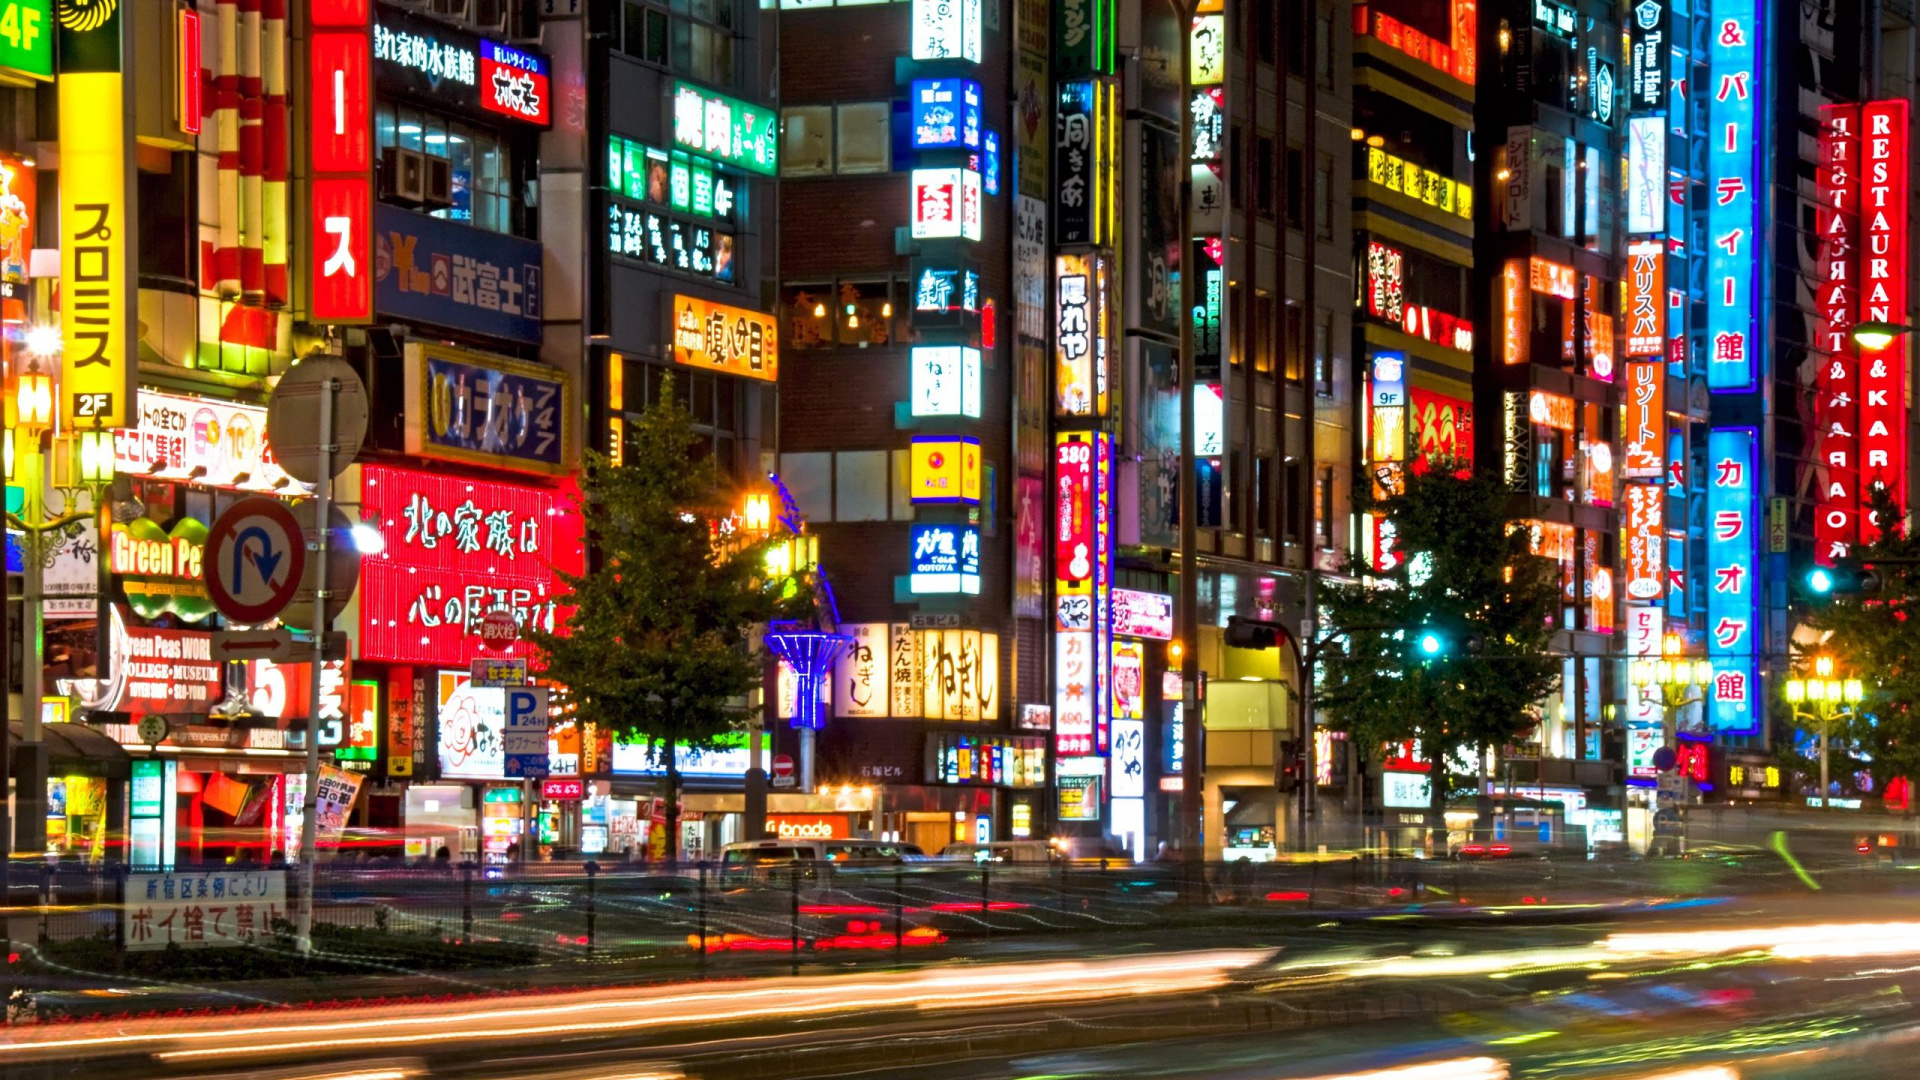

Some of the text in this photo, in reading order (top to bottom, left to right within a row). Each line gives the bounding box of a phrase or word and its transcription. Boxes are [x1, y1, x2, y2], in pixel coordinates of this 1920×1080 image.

[0, 3, 40, 51] 4F
[494, 45, 538, 72] 新しいタイプの
[1634, 43, 1644, 95] Glamorize
[1645, 31, 1661, 104] Trans Hair
[325, 69, 355, 277] ース
[714, 180, 732, 216] 4F
[696, 229, 709, 248] A5
[1066, 231, 1080, 241] 4F
[74, 203, 112, 368] プロミス
[452, 253, 523, 316] 武富士
[528, 269, 535, 314] 4F
[1206, 269, 1221, 356] EXCELSIOR
[1868, 114, 1892, 547] RESTAURAN & KARO
[706, 310, 762, 370] 腹八分目
[79, 394, 107, 416] 2F
[1380, 393, 1397, 405] 9F
[1634, 365, 1657, 446] リゾート
[534, 385, 557, 456] 747
[1059, 446, 1090, 464] 380
[1627, 441, 1662, 468] カフェ
[404, 492, 538, 560] 北の家族は
[1628, 486, 1645, 528] ネット
[1646, 486, 1662, 527] マンガ
[115, 532, 173, 577] Green
[178, 537, 205, 582] Pe
[917, 564, 954, 572] OOTOYA
[1630, 536, 1644, 580] シャワー
[1633, 582, 1657, 595] 24H
[1714, 458, 1747, 703] カラオケ館
[484, 622, 515, 640] 消火栓
[914, 615, 958, 631] 石塚ビル
[155, 635, 181, 659] Peas
[182, 637, 211, 661] WORL
[895, 637, 912, 683] たん焼
[173, 664, 219, 683] MUSEUM
[254, 658, 286, 718] 5
[847, 639, 873, 708] ねぎし
[931, 636, 993, 711] ねぎし
[413, 678, 425, 764] 隠れ家的水族館
[510, 692, 537, 726] P
[522, 716, 545, 727] 24H
[393, 757, 408, 767] B1F
[508, 736, 545, 749] サブナード
[548, 758, 578, 774] 4H
[861, 765, 903, 777] 石塚ビル
[146, 876, 269, 901] 新宿区条例により
[130, 902, 283, 943] ポイ捨て禁止
